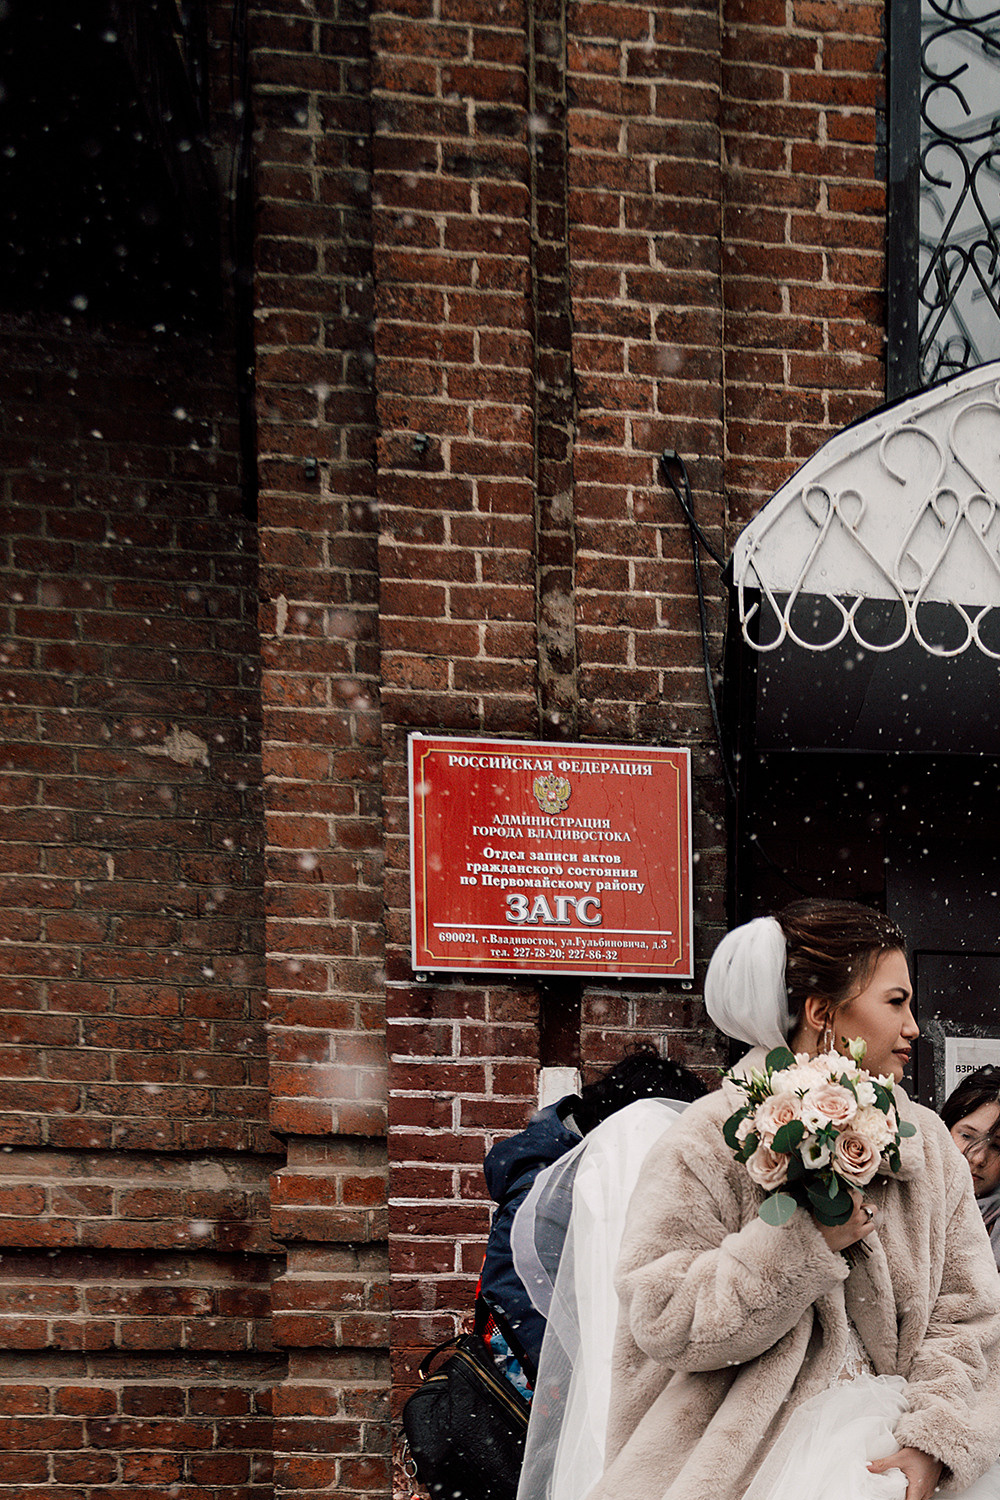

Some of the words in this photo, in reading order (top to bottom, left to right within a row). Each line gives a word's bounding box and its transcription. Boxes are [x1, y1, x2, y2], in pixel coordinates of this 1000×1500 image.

[448, 755, 553, 771] РОССИЙСКАЯ
[558, 760, 653, 776] ФЕДЕРАЦИЯ
[493, 814, 611, 829] АДМИНИСТРАЦИЯ
[472, 826, 524, 839] ГОРОДА
[527, 828, 631, 842] ВЛАДИВОСТОКА
[483, 847, 525, 861] Отдел
[529, 852, 578, 862] записи
[582, 853, 622, 864] актов
[466, 862, 564, 875] гражданского
[567, 867, 639, 878] состояния
[460, 875, 477, 885] по
[481, 874, 592, 893] Первомайскому
[595, 879, 646, 895] району
[505, 893, 603, 926] ЗАГС
[439, 932, 479, 944] 690021,
[482, 934, 558, 947] г.Владивосток,
[652, 939, 668, 950] д.3
[490, 949, 510, 958] тел.
[513, 947, 566, 960] 227-78-20;
[568, 949, 618, 960] 227-86-32
